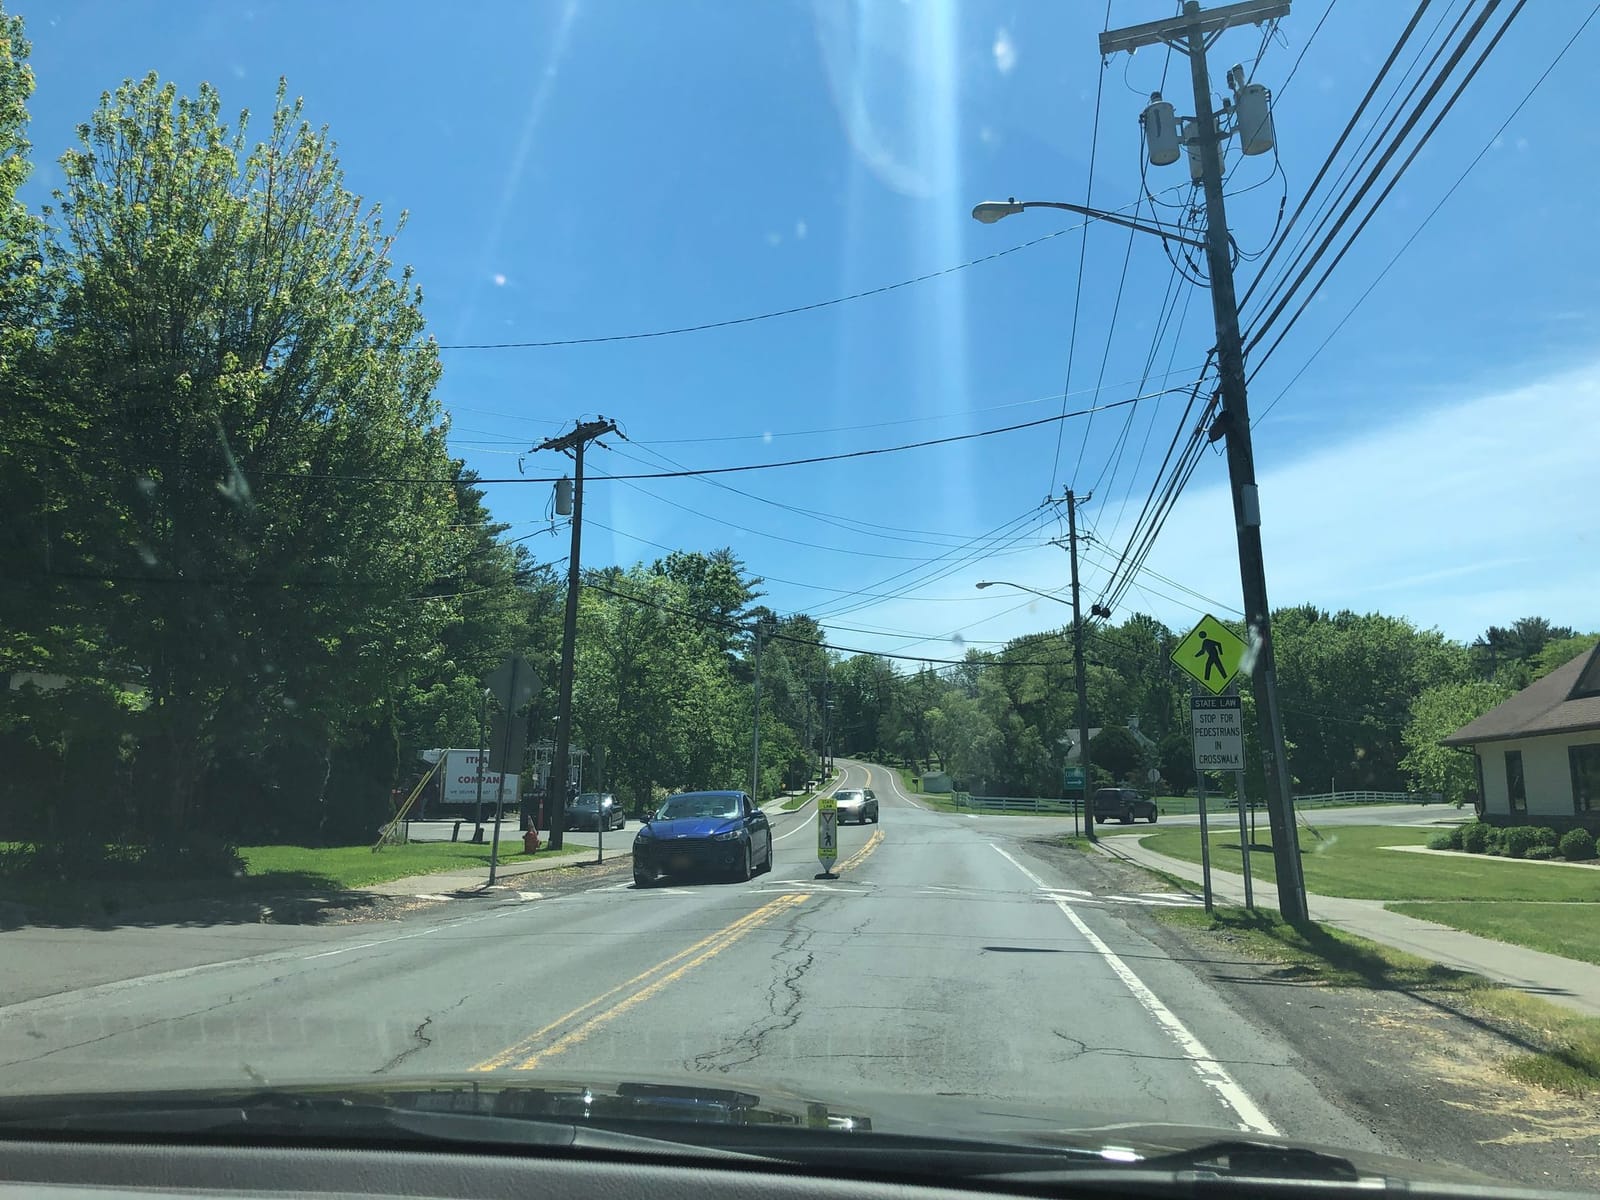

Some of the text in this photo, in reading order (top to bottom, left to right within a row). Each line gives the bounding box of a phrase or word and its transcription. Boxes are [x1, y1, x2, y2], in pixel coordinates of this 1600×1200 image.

[1195, 699, 1236, 707] STATE LAW
[1199, 714, 1234, 724] STOP FOR
[1195, 727, 1240, 737] PEDESTRIANS
[1214, 741, 1222, 750] IN
[1199, 754, 1239, 764] CROSSWALK
[458, 776, 504, 785] COMPAN
